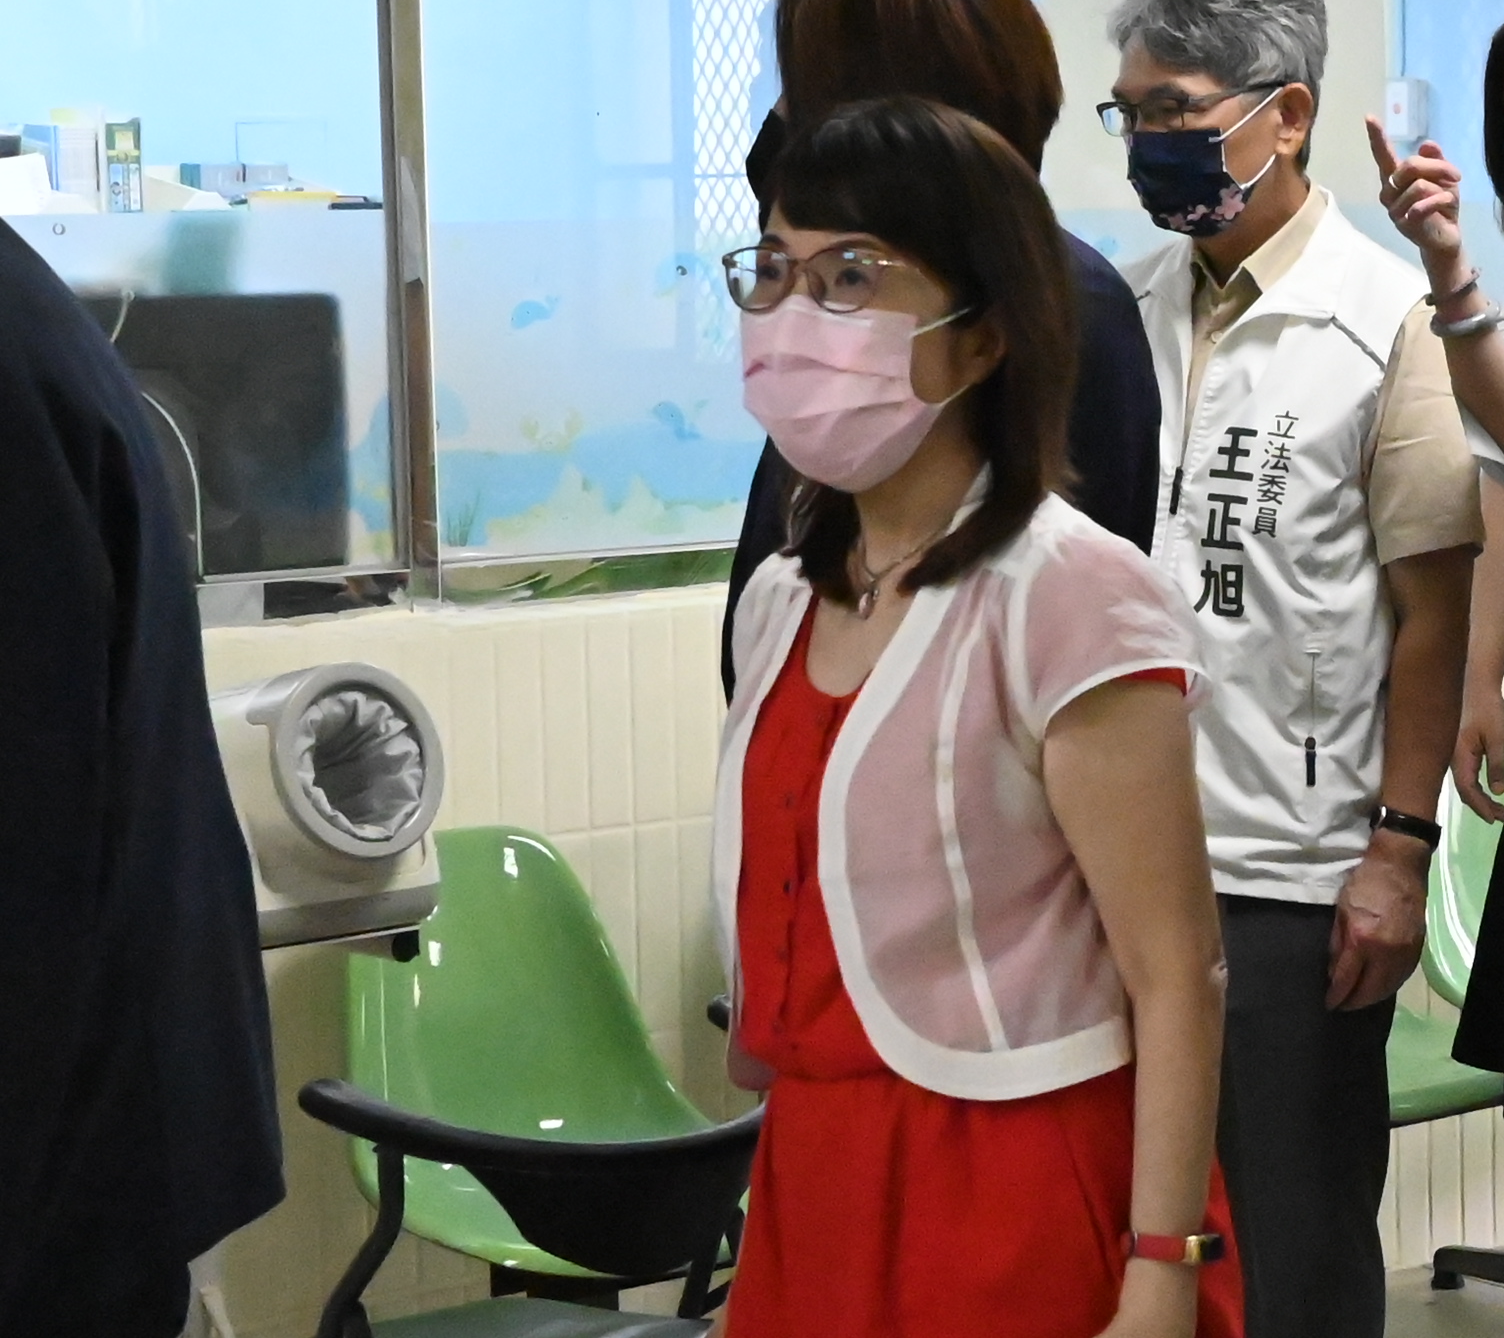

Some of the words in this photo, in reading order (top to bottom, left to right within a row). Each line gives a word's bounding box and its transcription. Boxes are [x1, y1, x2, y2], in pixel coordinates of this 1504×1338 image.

[1193, 426, 1259, 618] 王正旭
[1252, 410, 1300, 538] 立法委員
